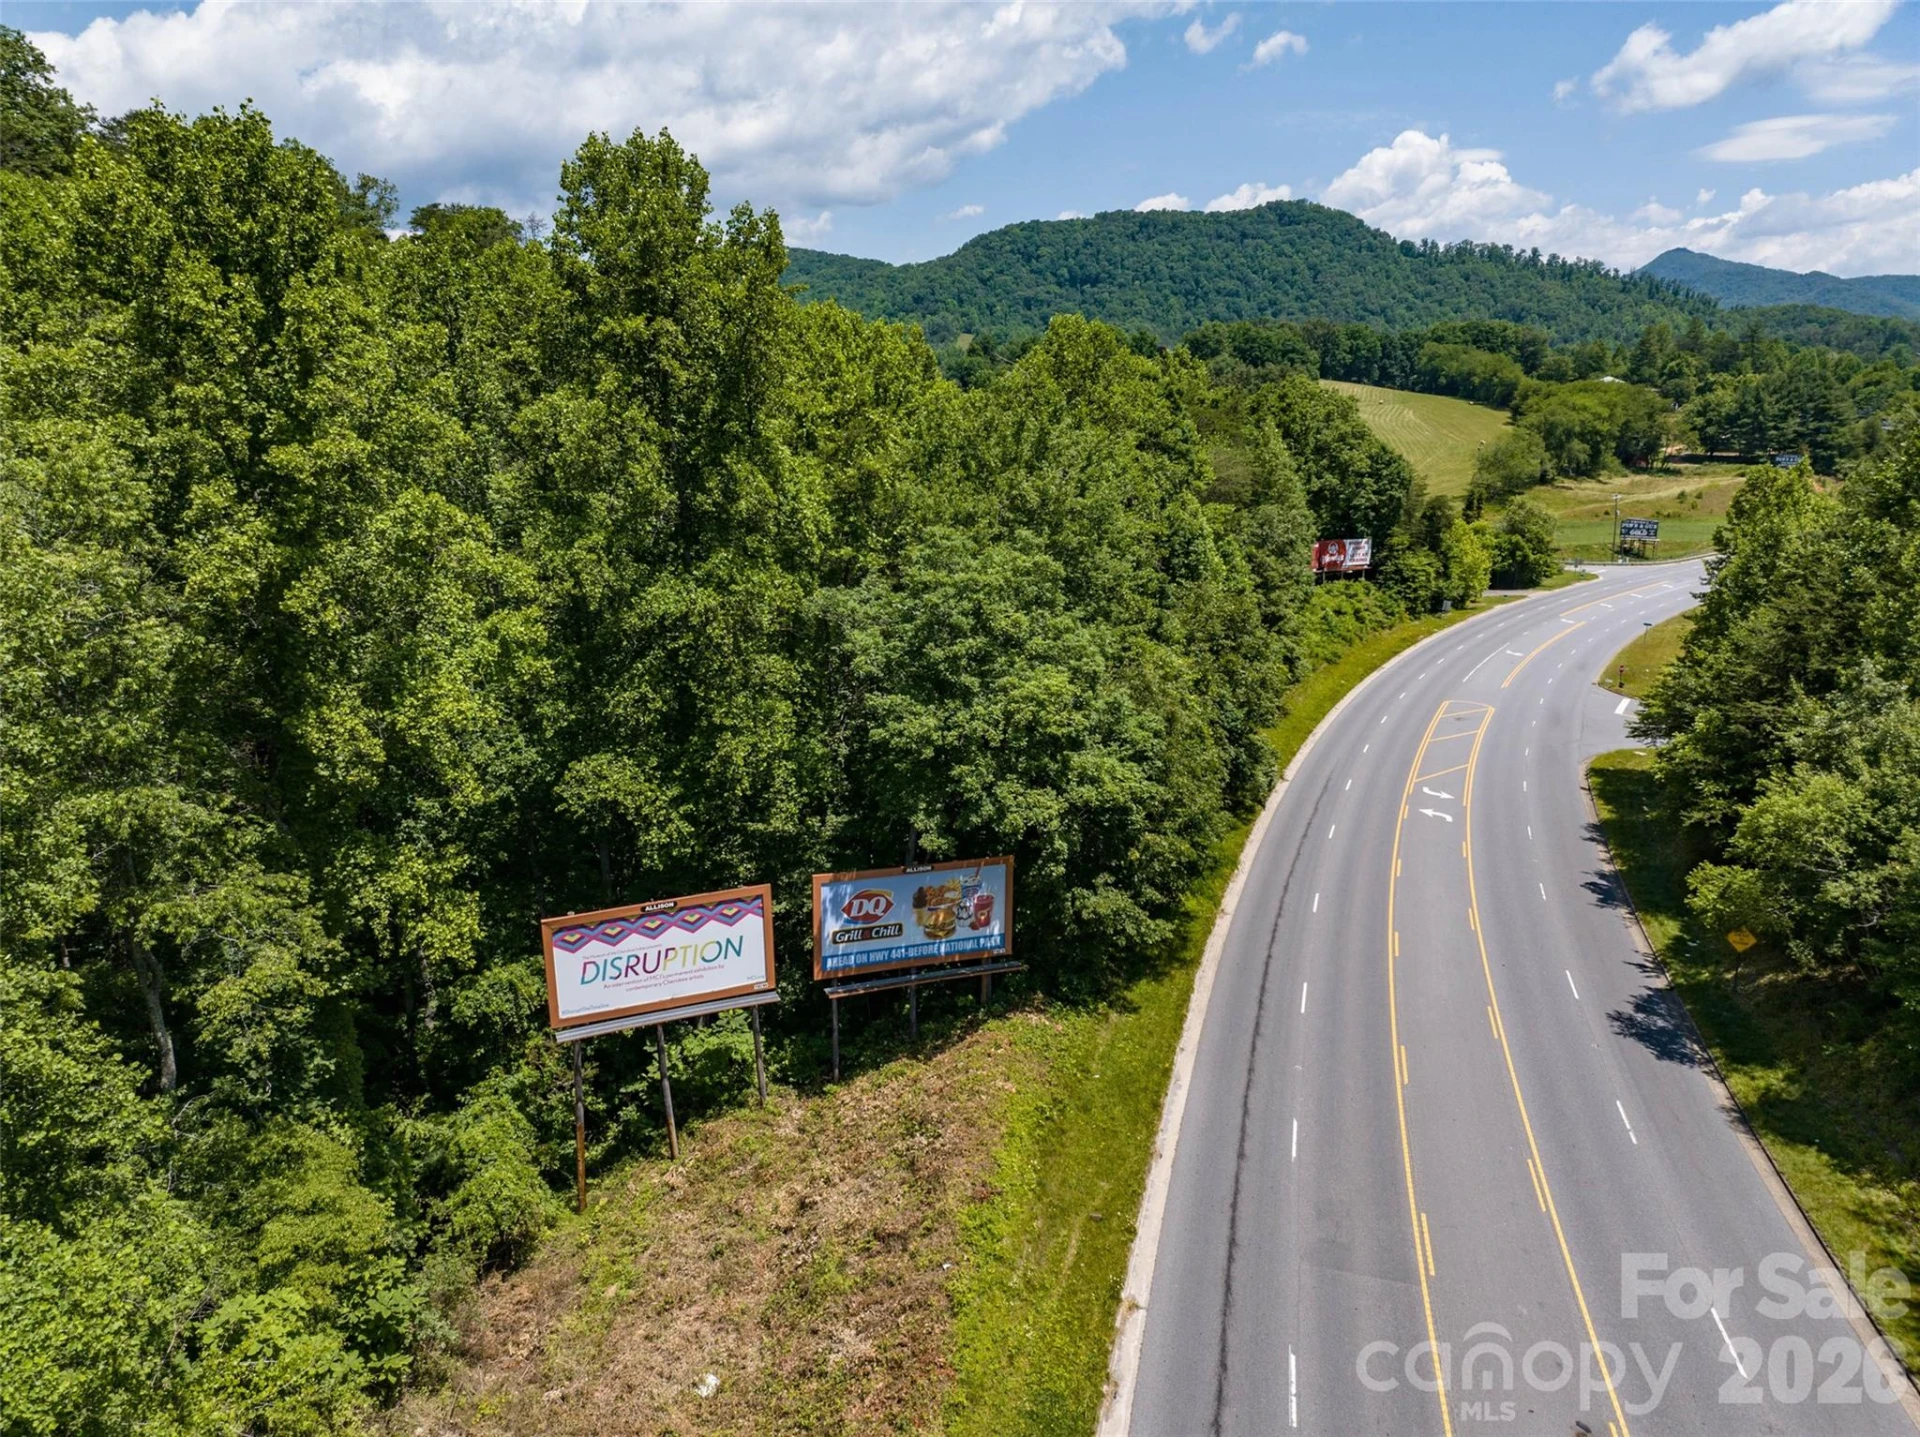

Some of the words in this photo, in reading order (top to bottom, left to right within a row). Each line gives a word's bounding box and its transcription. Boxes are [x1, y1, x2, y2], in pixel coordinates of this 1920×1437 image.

[906, 865, 931, 873] ALLISON
[645, 902, 674, 911] ALLISON
[849, 896, 887, 917] DQ
[835, 929, 862, 942] Grill
[871, 924, 900, 938] Chill
[580, 935, 743, 986] DISRUPTION
[856, 952, 868, 964] ON
[869, 949, 889, 962] HWY
